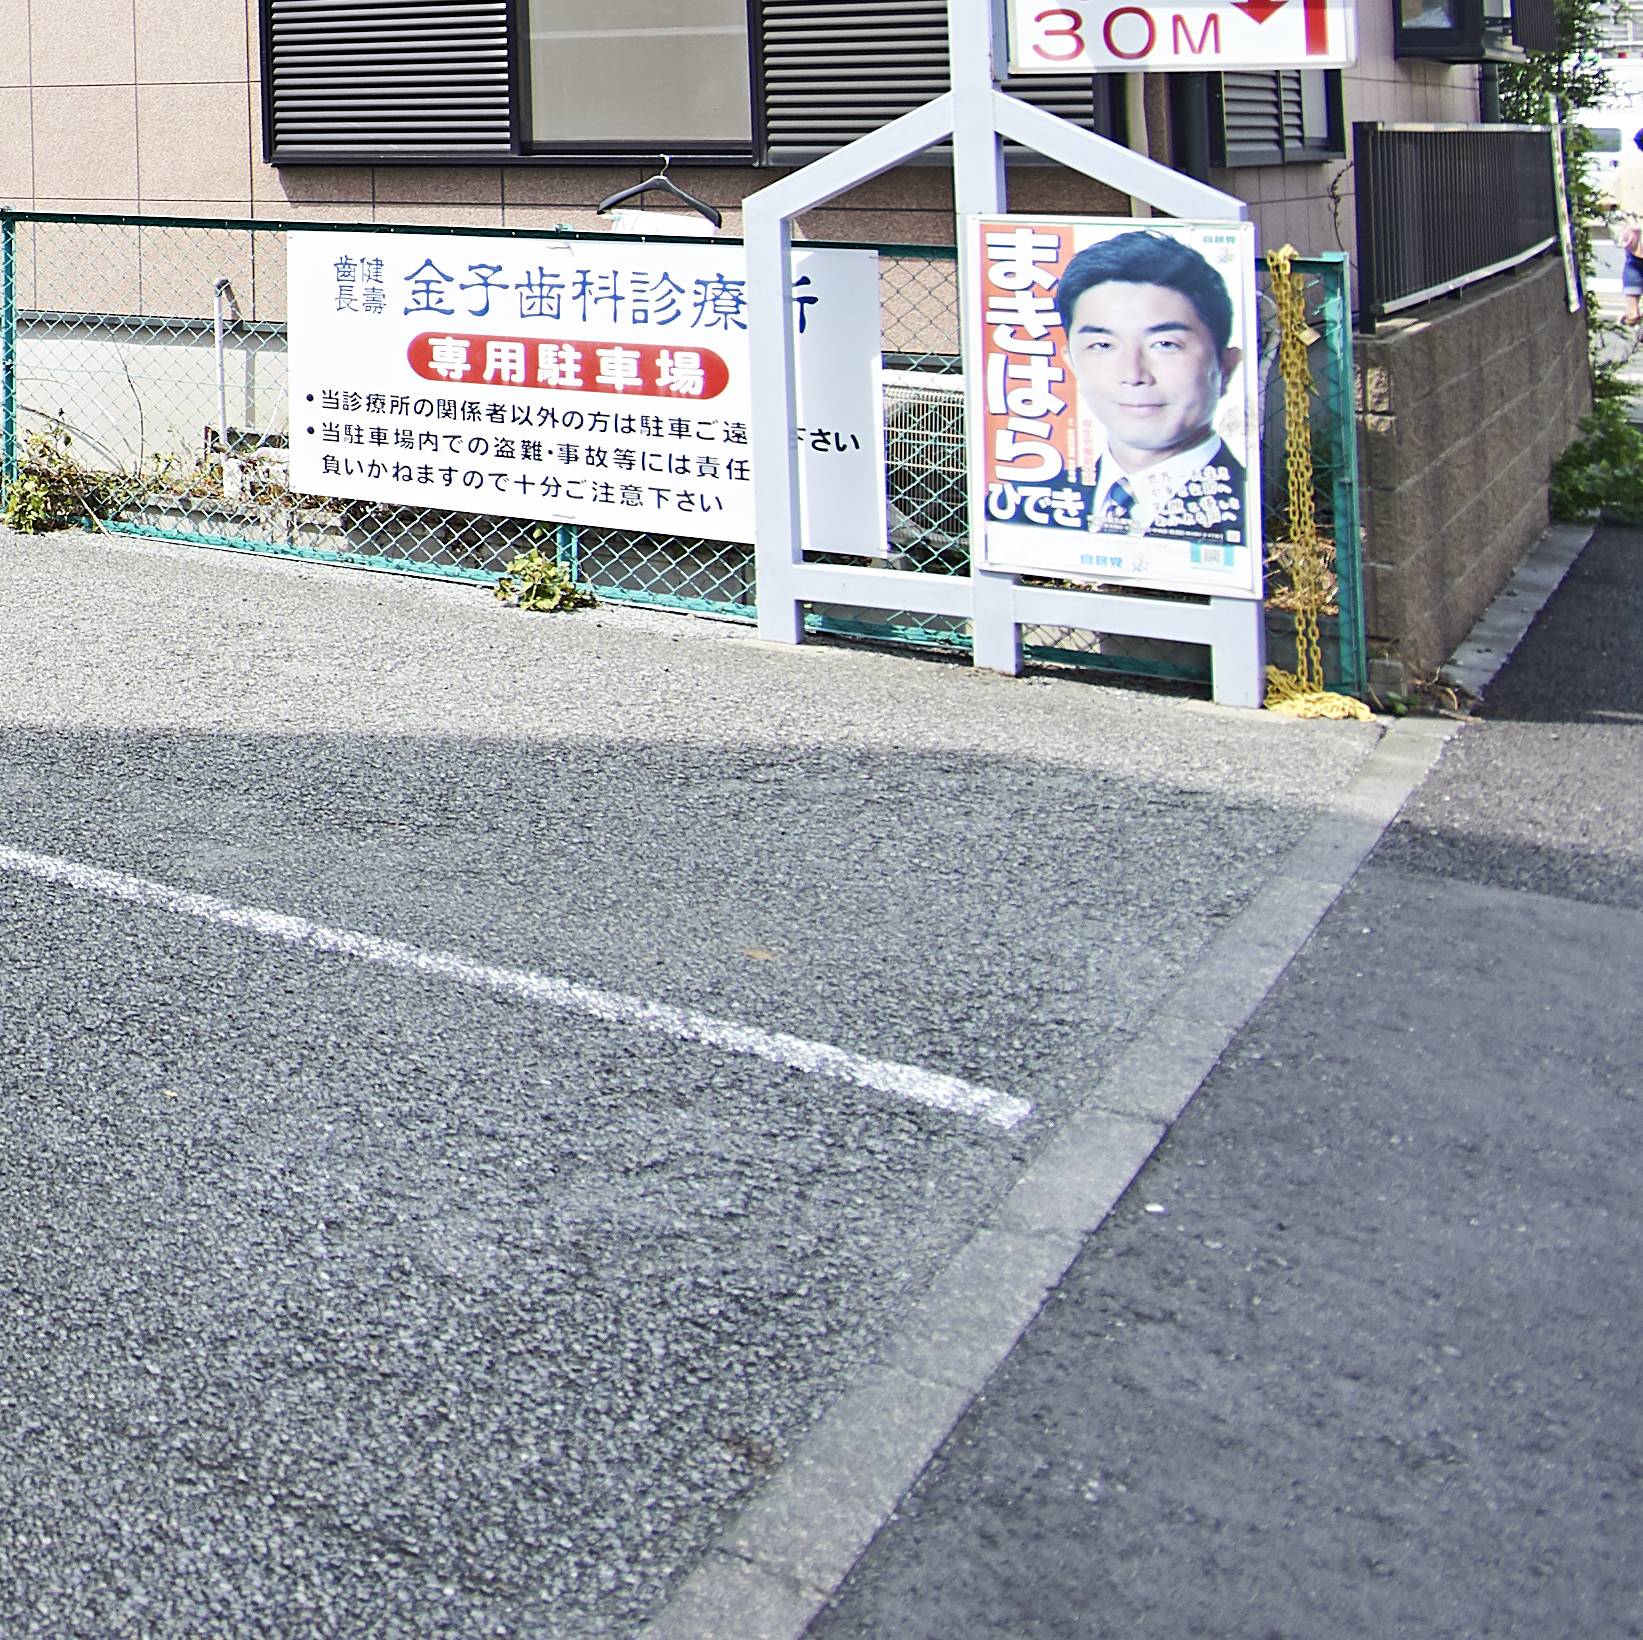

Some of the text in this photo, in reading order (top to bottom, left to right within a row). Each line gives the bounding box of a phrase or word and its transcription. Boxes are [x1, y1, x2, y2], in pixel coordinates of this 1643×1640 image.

[427, 335, 707, 396] 専用駐車場
[985, 227, 1067, 484] まきはら
[321, 454, 724, 513] 負いかねますので十分ご注意下さい
[987, 482, 1086, 528] ひでき
